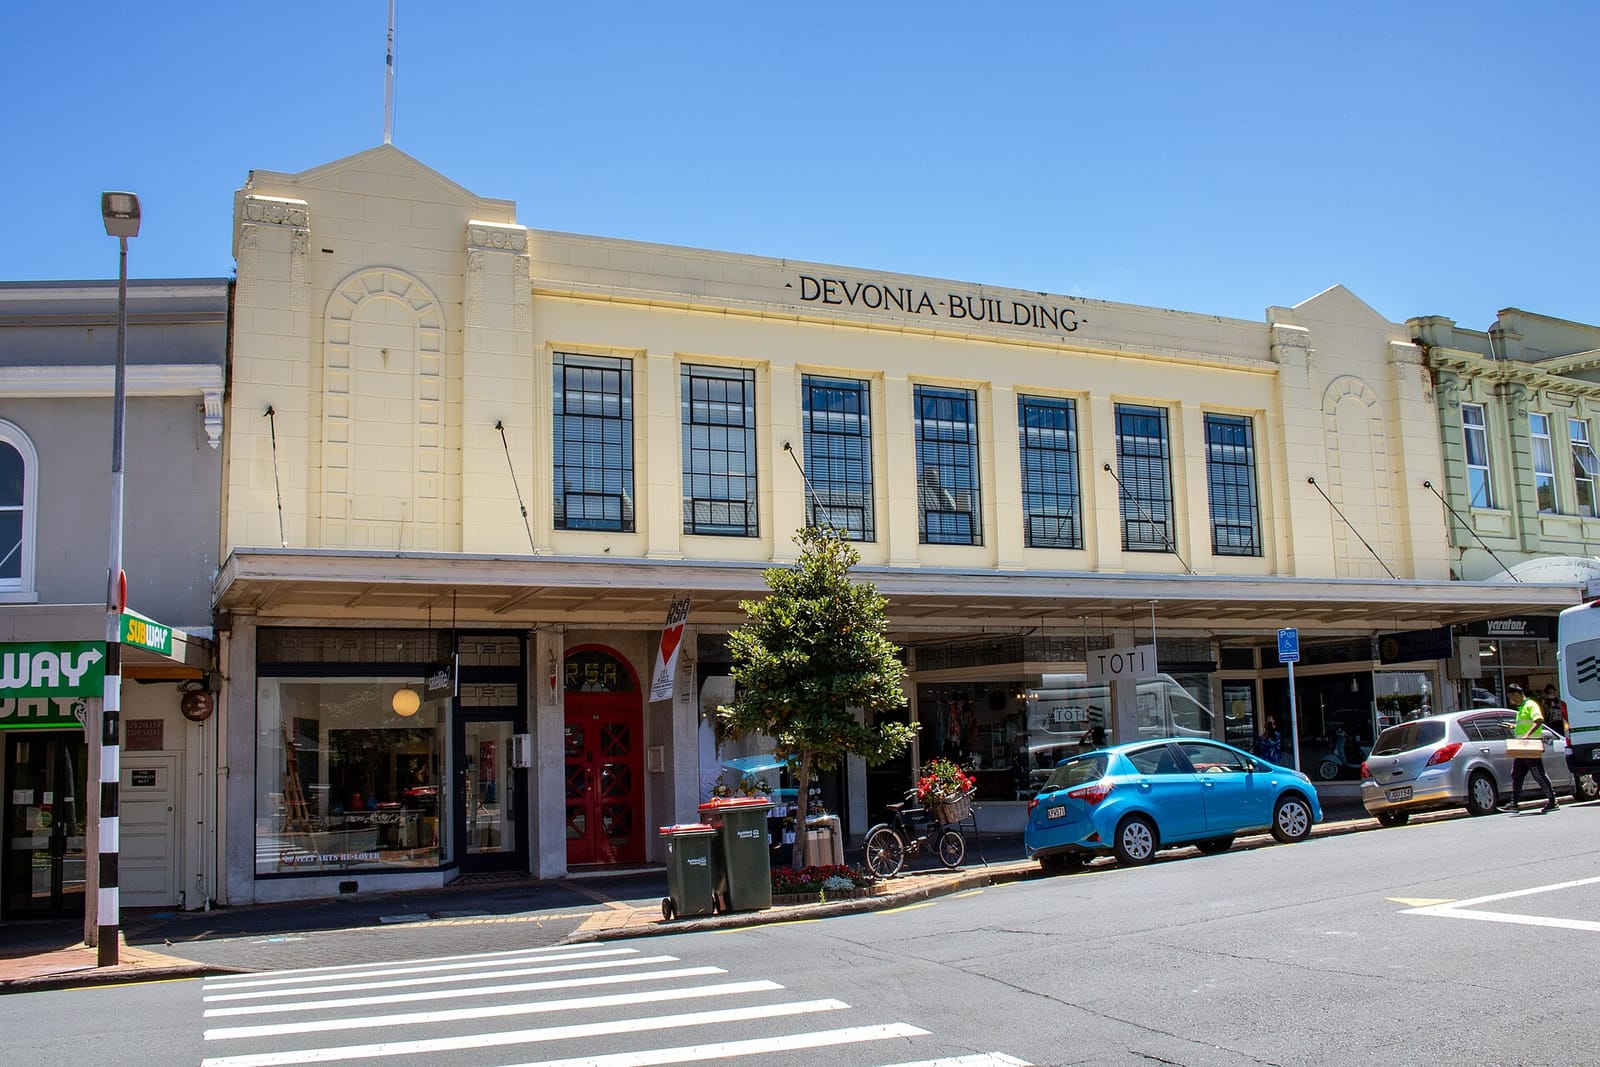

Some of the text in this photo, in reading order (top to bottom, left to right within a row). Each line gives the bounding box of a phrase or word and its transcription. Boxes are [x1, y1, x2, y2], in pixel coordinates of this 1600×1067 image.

[799, 275, 1079, 332] DEVONIA BUILDING
[665, 597, 691, 626] RSA
[127, 619, 168, 650] SUBWAY
[1097, 651, 1145, 675] TOTI
[1056, 710, 1085, 721] TOTI
